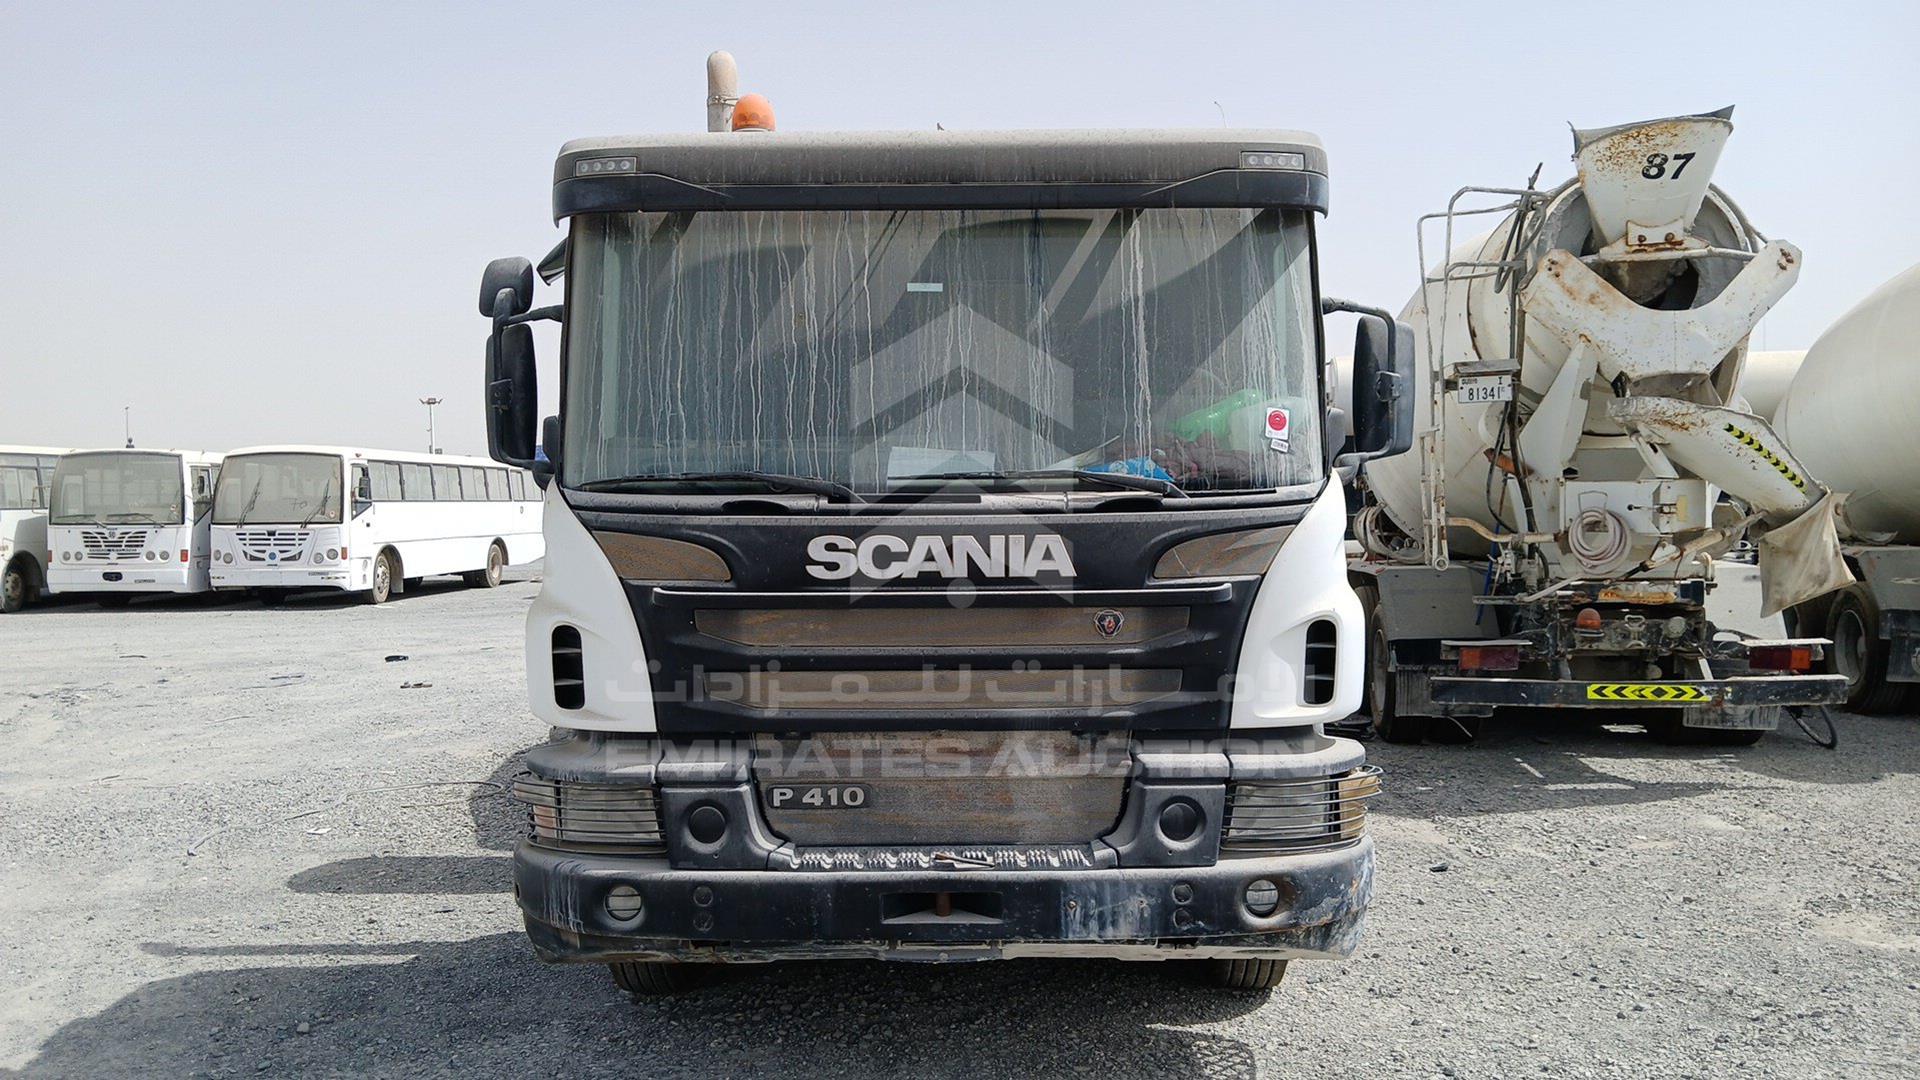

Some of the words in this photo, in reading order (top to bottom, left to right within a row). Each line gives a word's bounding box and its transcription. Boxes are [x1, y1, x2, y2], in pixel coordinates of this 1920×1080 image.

[1642, 152, 1697, 179] 87
[1468, 386, 1501, 400] 81341
[805, 535, 1077, 580] SCANIA
[773, 788, 794, 806] P
[802, 787, 865, 806] 410
